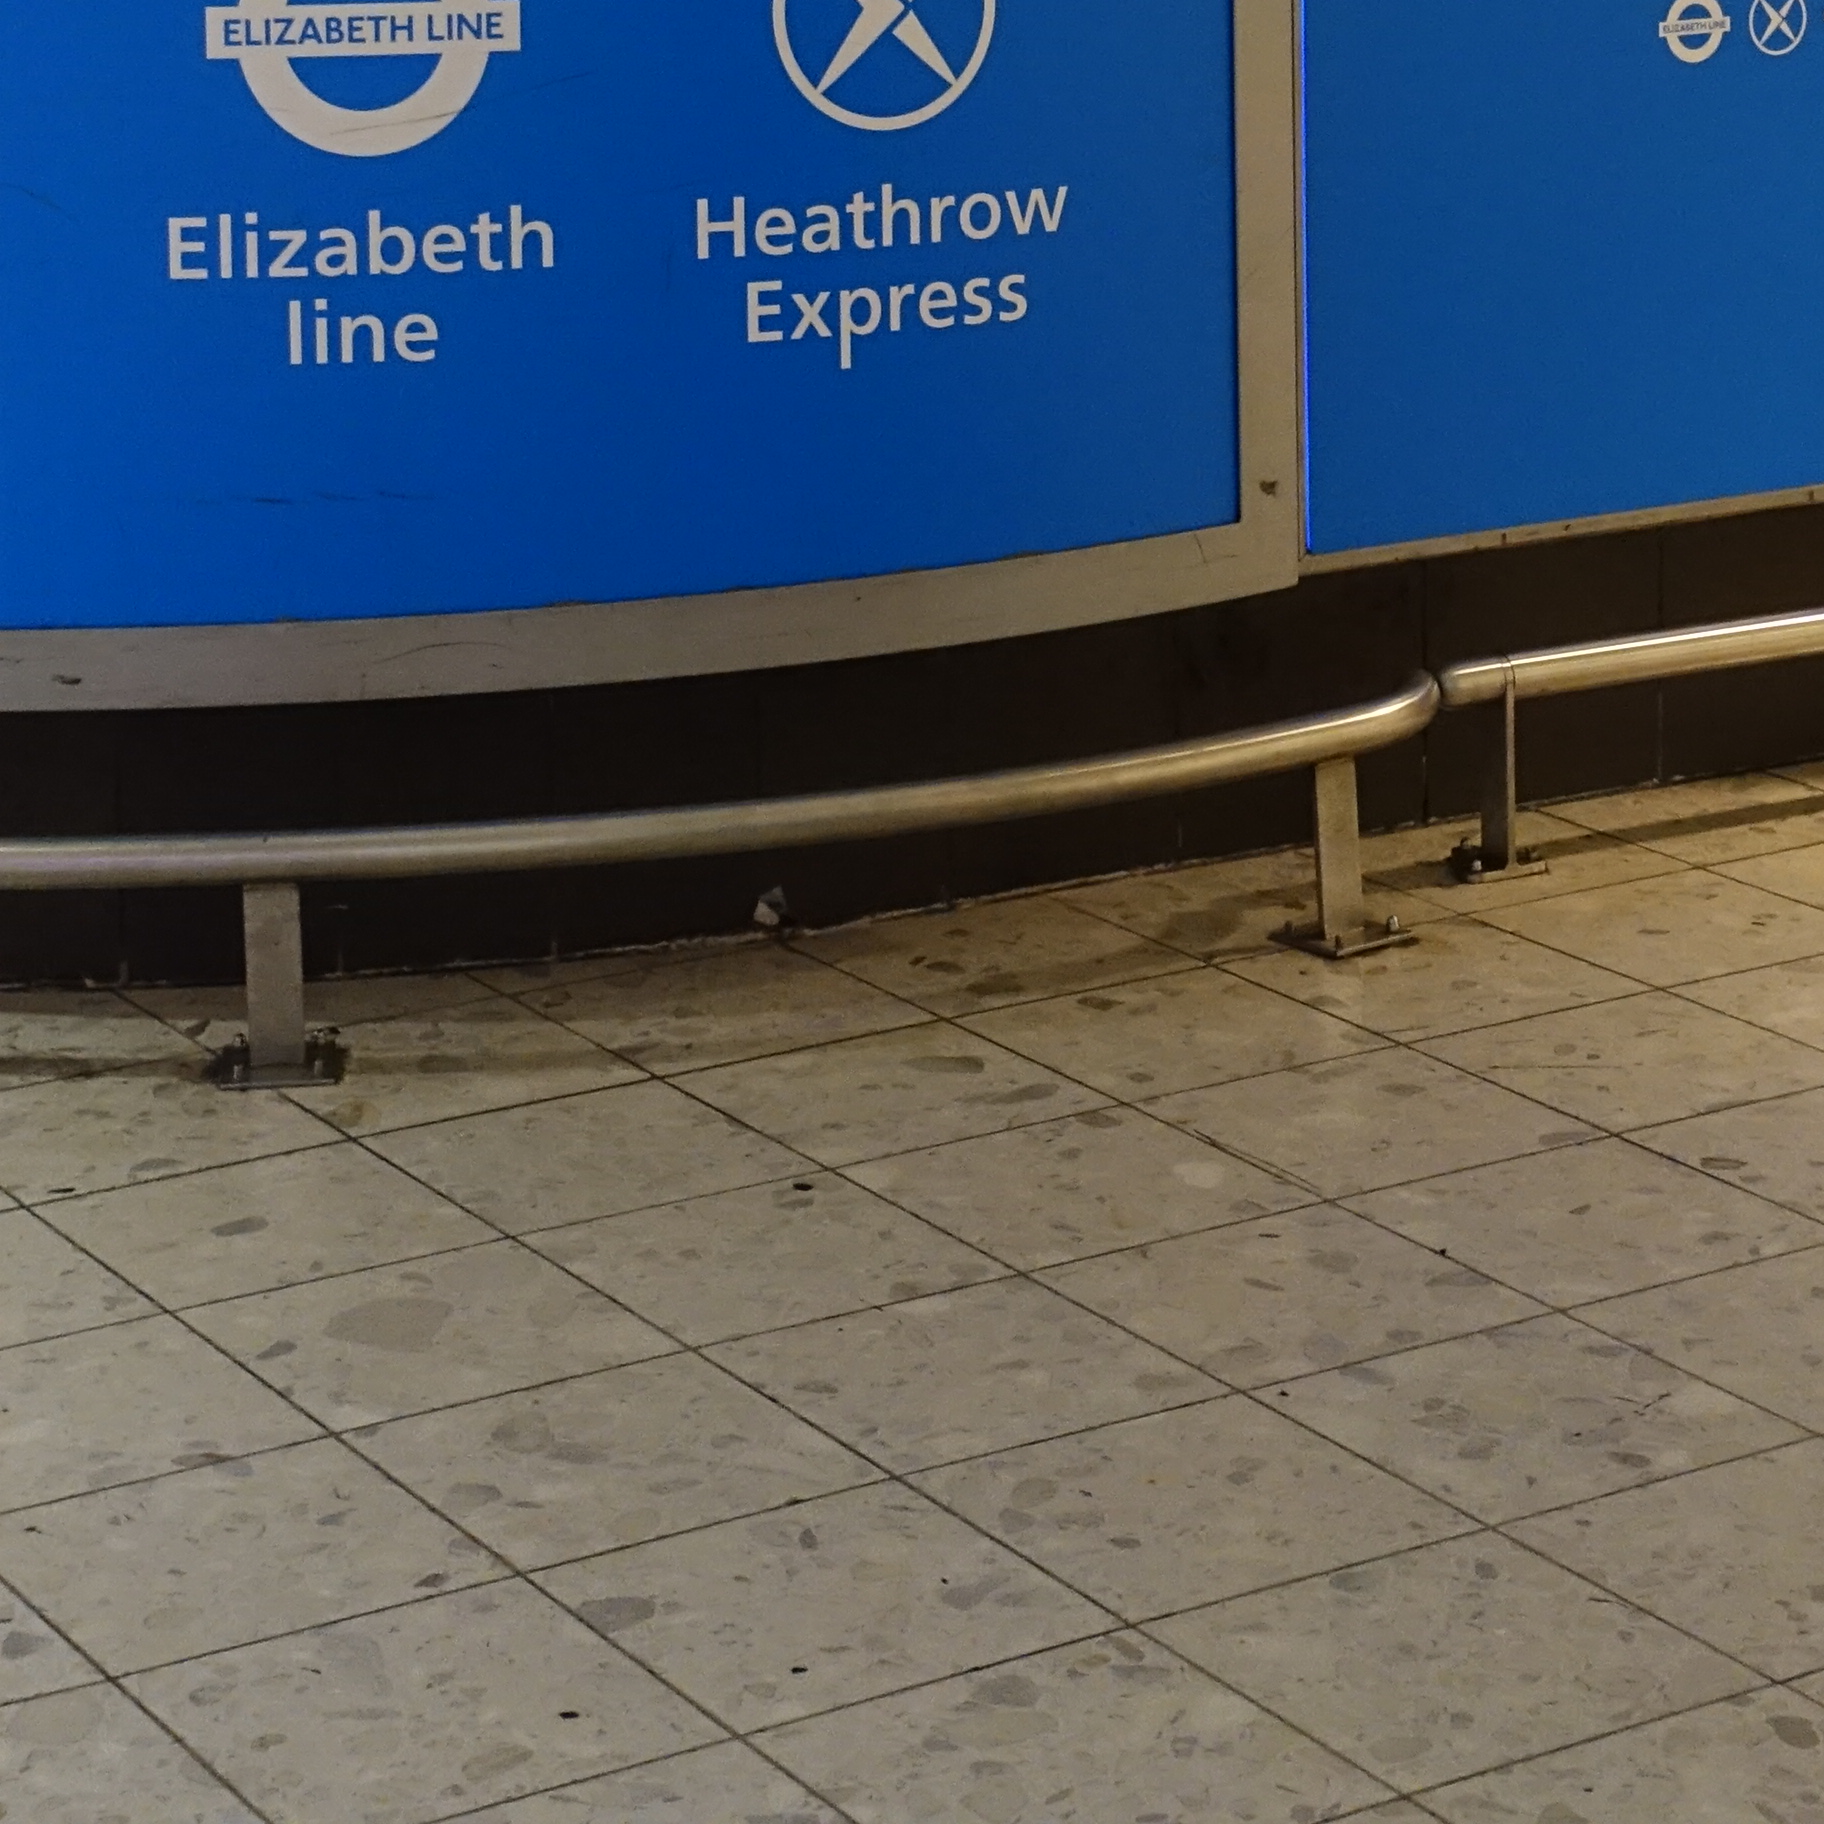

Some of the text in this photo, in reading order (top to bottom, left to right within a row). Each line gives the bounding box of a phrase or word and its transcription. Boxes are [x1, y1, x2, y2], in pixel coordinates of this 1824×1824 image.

[222, 11, 506, 48] ELIZABETH LINE
[168, 205, 553, 279] Elizabeth
[697, 184, 1067, 259] Heathrow
[289, 299, 438, 364] line
[747, 274, 1027, 369] Express
